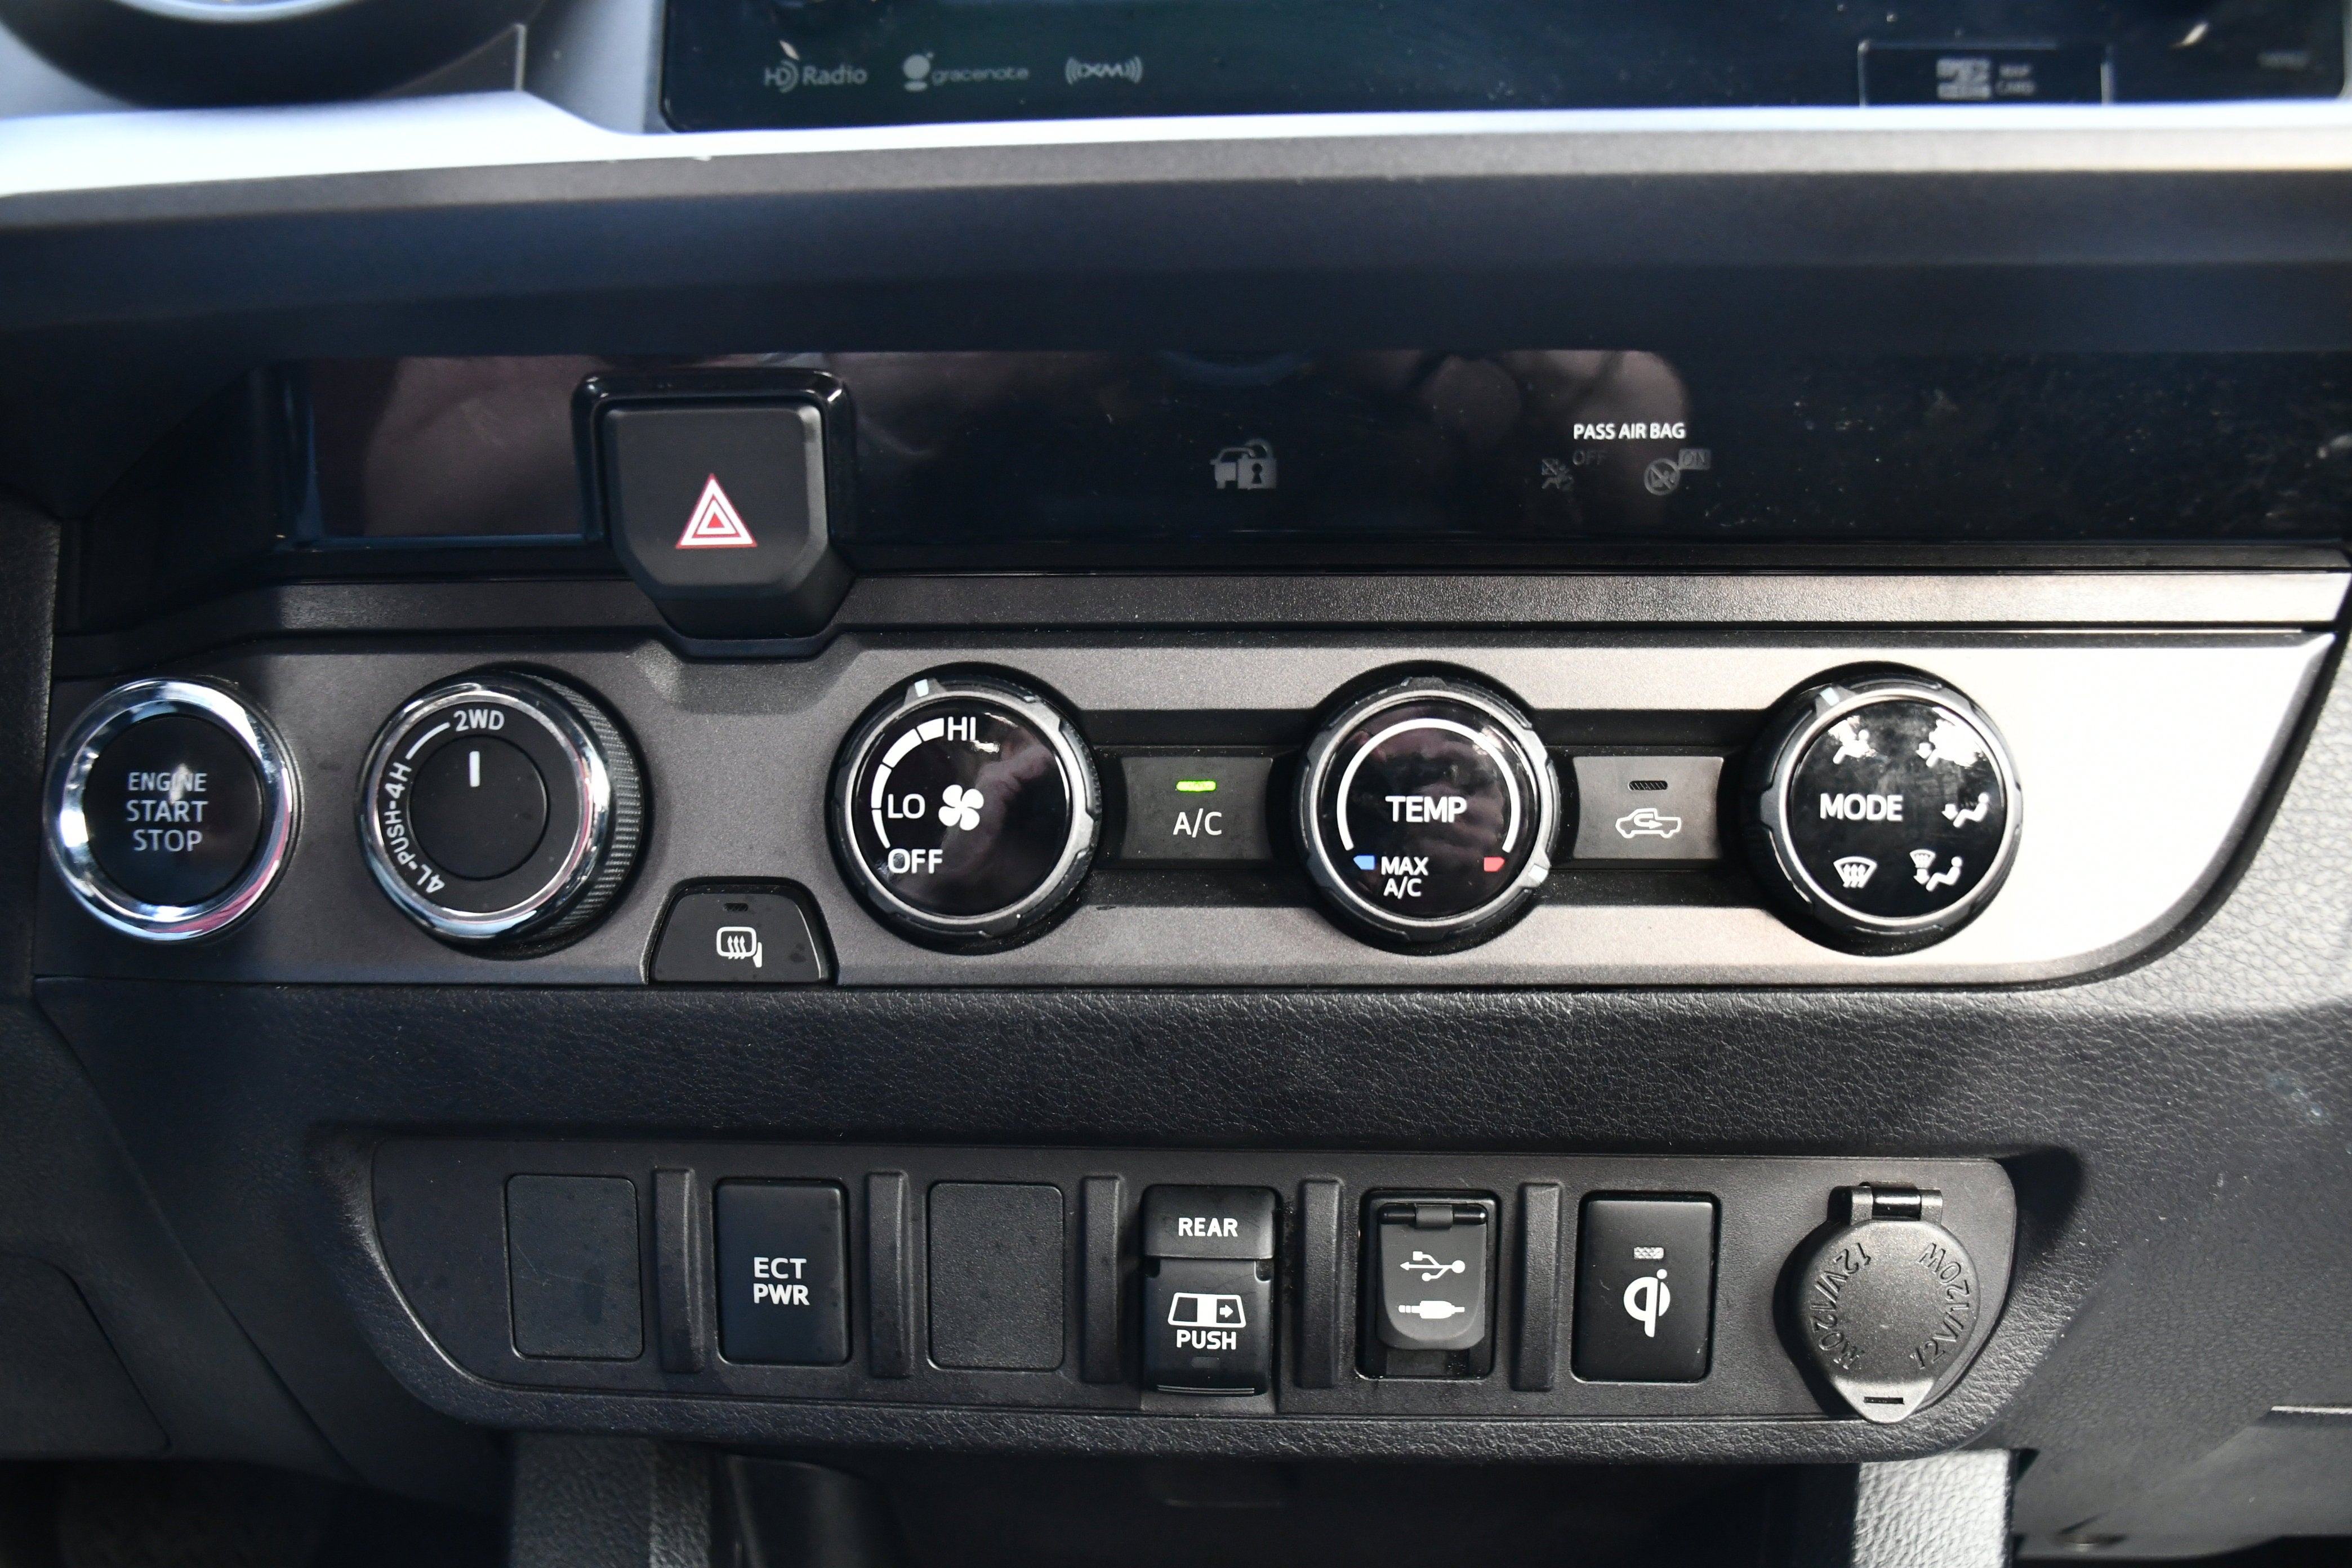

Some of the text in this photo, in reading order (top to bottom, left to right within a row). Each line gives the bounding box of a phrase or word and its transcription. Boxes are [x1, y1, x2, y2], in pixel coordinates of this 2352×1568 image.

[802, 64, 868, 86] Radio
[931, 67, 1030, 86] gracenote
[1573, 422, 1686, 440] PASS AIR BAG
[453, 709, 505, 732] 2WD
[947, 717, 976, 741] HI
[128, 772, 207, 793] ENGINE
[126, 799, 208, 823] START
[887, 794, 925, 819] LO
[1385, 795, 1468, 823] TEMP
[1819, 793, 1904, 821] MODE
[1173, 808, 1222, 838] A/C
[133, 829, 203, 852] STOP
[888, 849, 943, 874] OFF
[1381, 856, 1429, 876] MAX
[1383, 876, 1422, 900] A/C
[1178, 1217, 1238, 1237] REAR
[754, 1257, 807, 1279] ECT
[753, 1283, 810, 1306] PWR
[1176, 1329, 1237, 1350] PUSH
